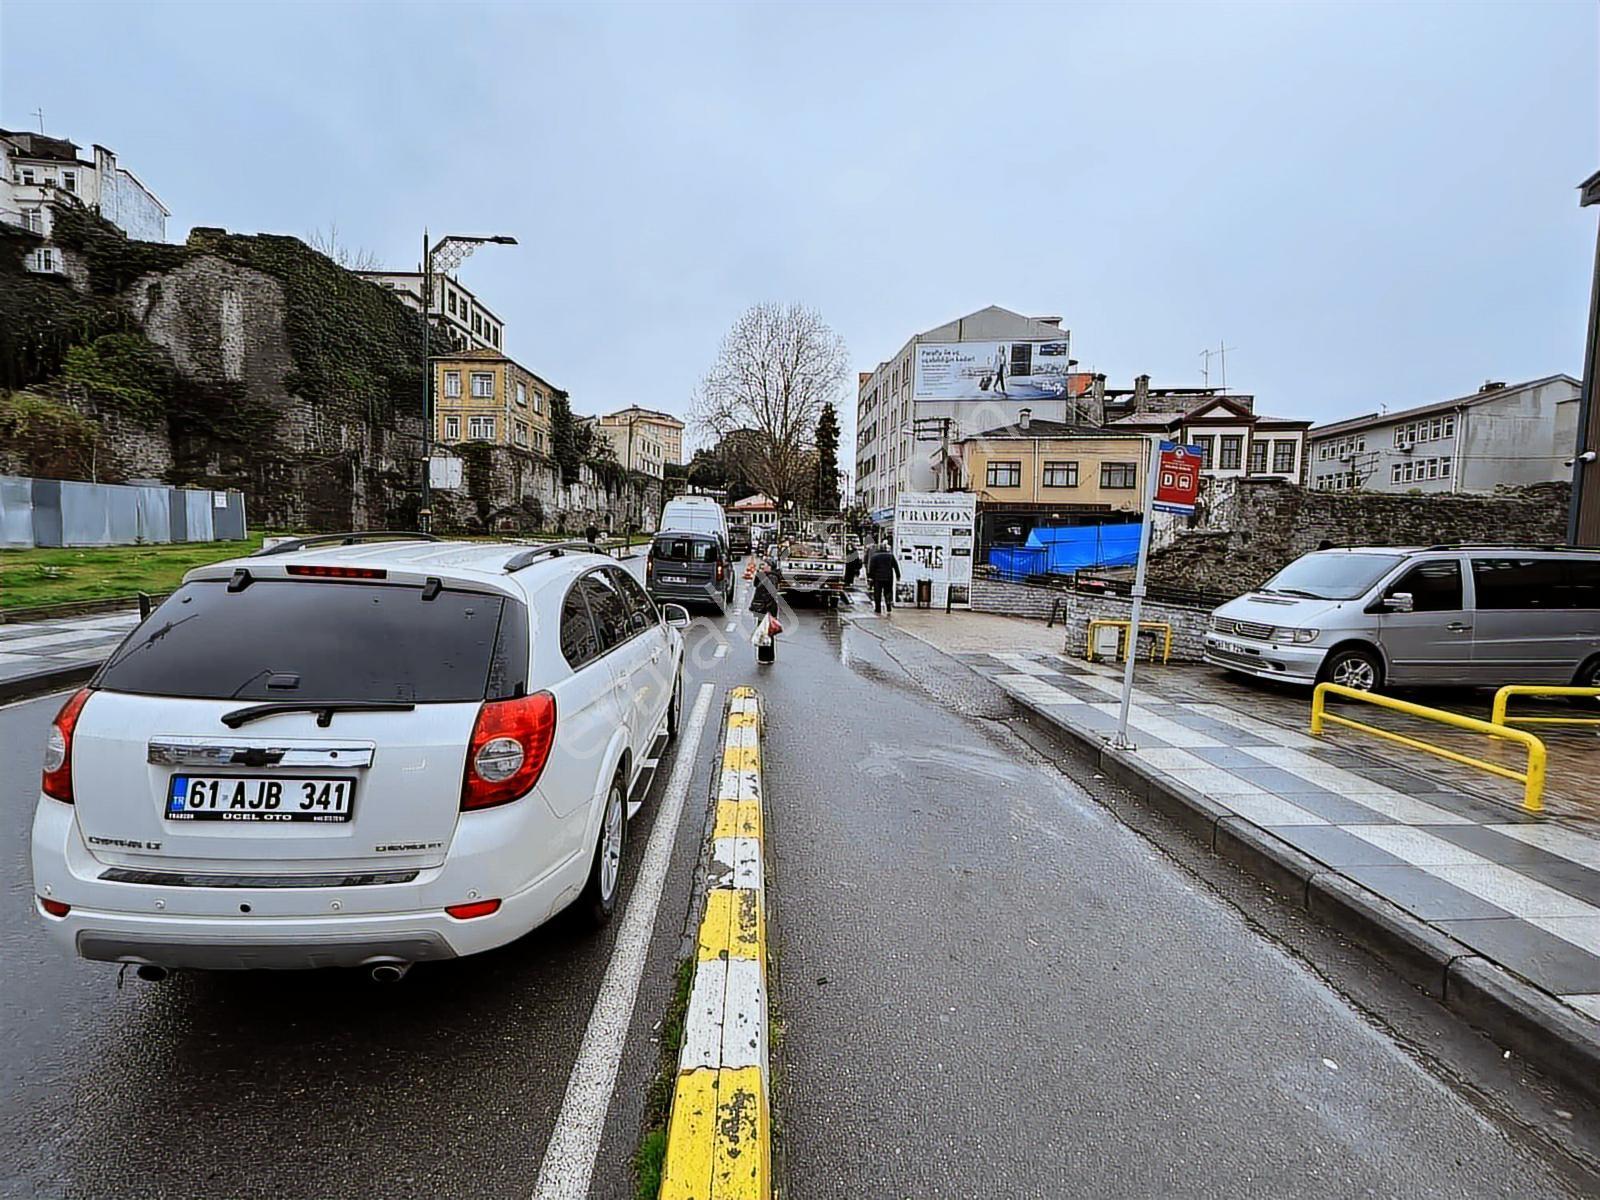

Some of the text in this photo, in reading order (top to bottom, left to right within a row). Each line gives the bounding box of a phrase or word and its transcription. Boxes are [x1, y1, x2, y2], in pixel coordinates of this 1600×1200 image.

[1164, 473, 1173, 486] D
[898, 509, 972, 522] TRABZON
[788, 562, 835, 571] ISUZU
[173, 796, 185, 805] TR
[189, 780, 345, 810] 61 AJB 341
[263, 813, 292, 821] OTO
